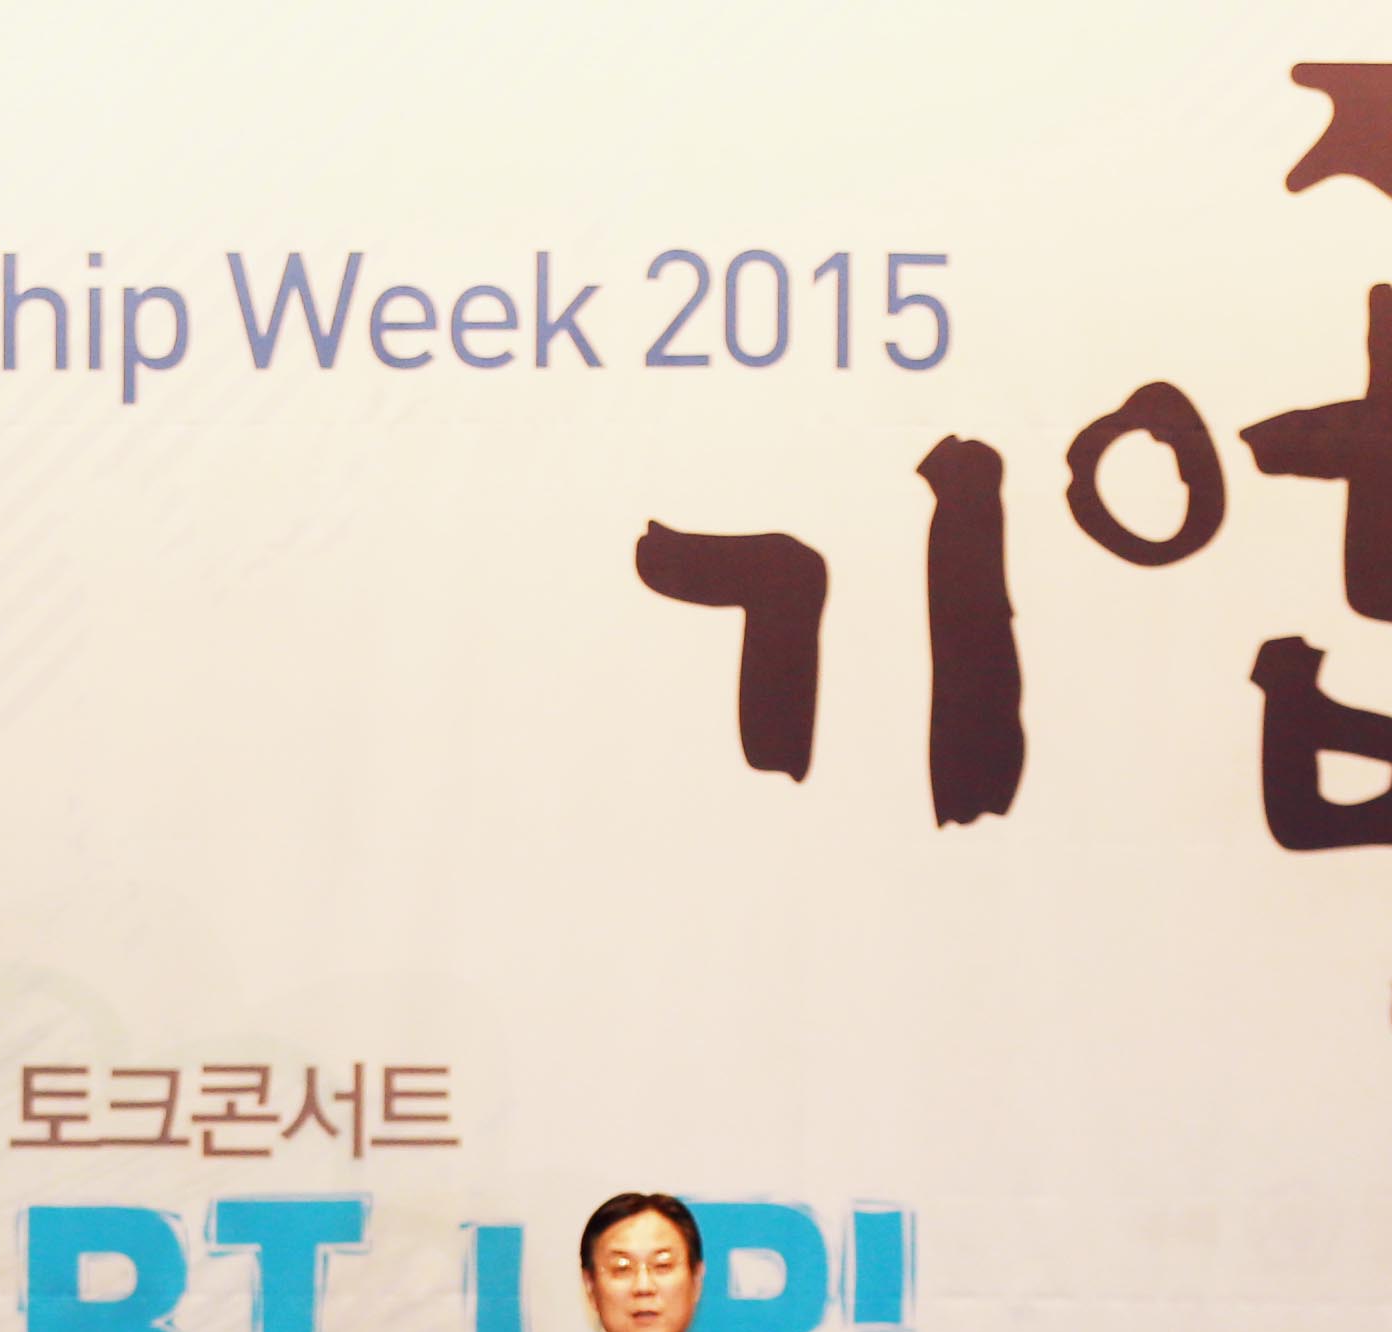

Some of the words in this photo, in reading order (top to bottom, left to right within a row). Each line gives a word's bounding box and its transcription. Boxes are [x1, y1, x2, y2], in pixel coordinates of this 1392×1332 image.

[225, 250, 605, 371] Week
[644, 248, 952, 373] 2015
[8, 1061, 461, 1161] 토크콘서트
